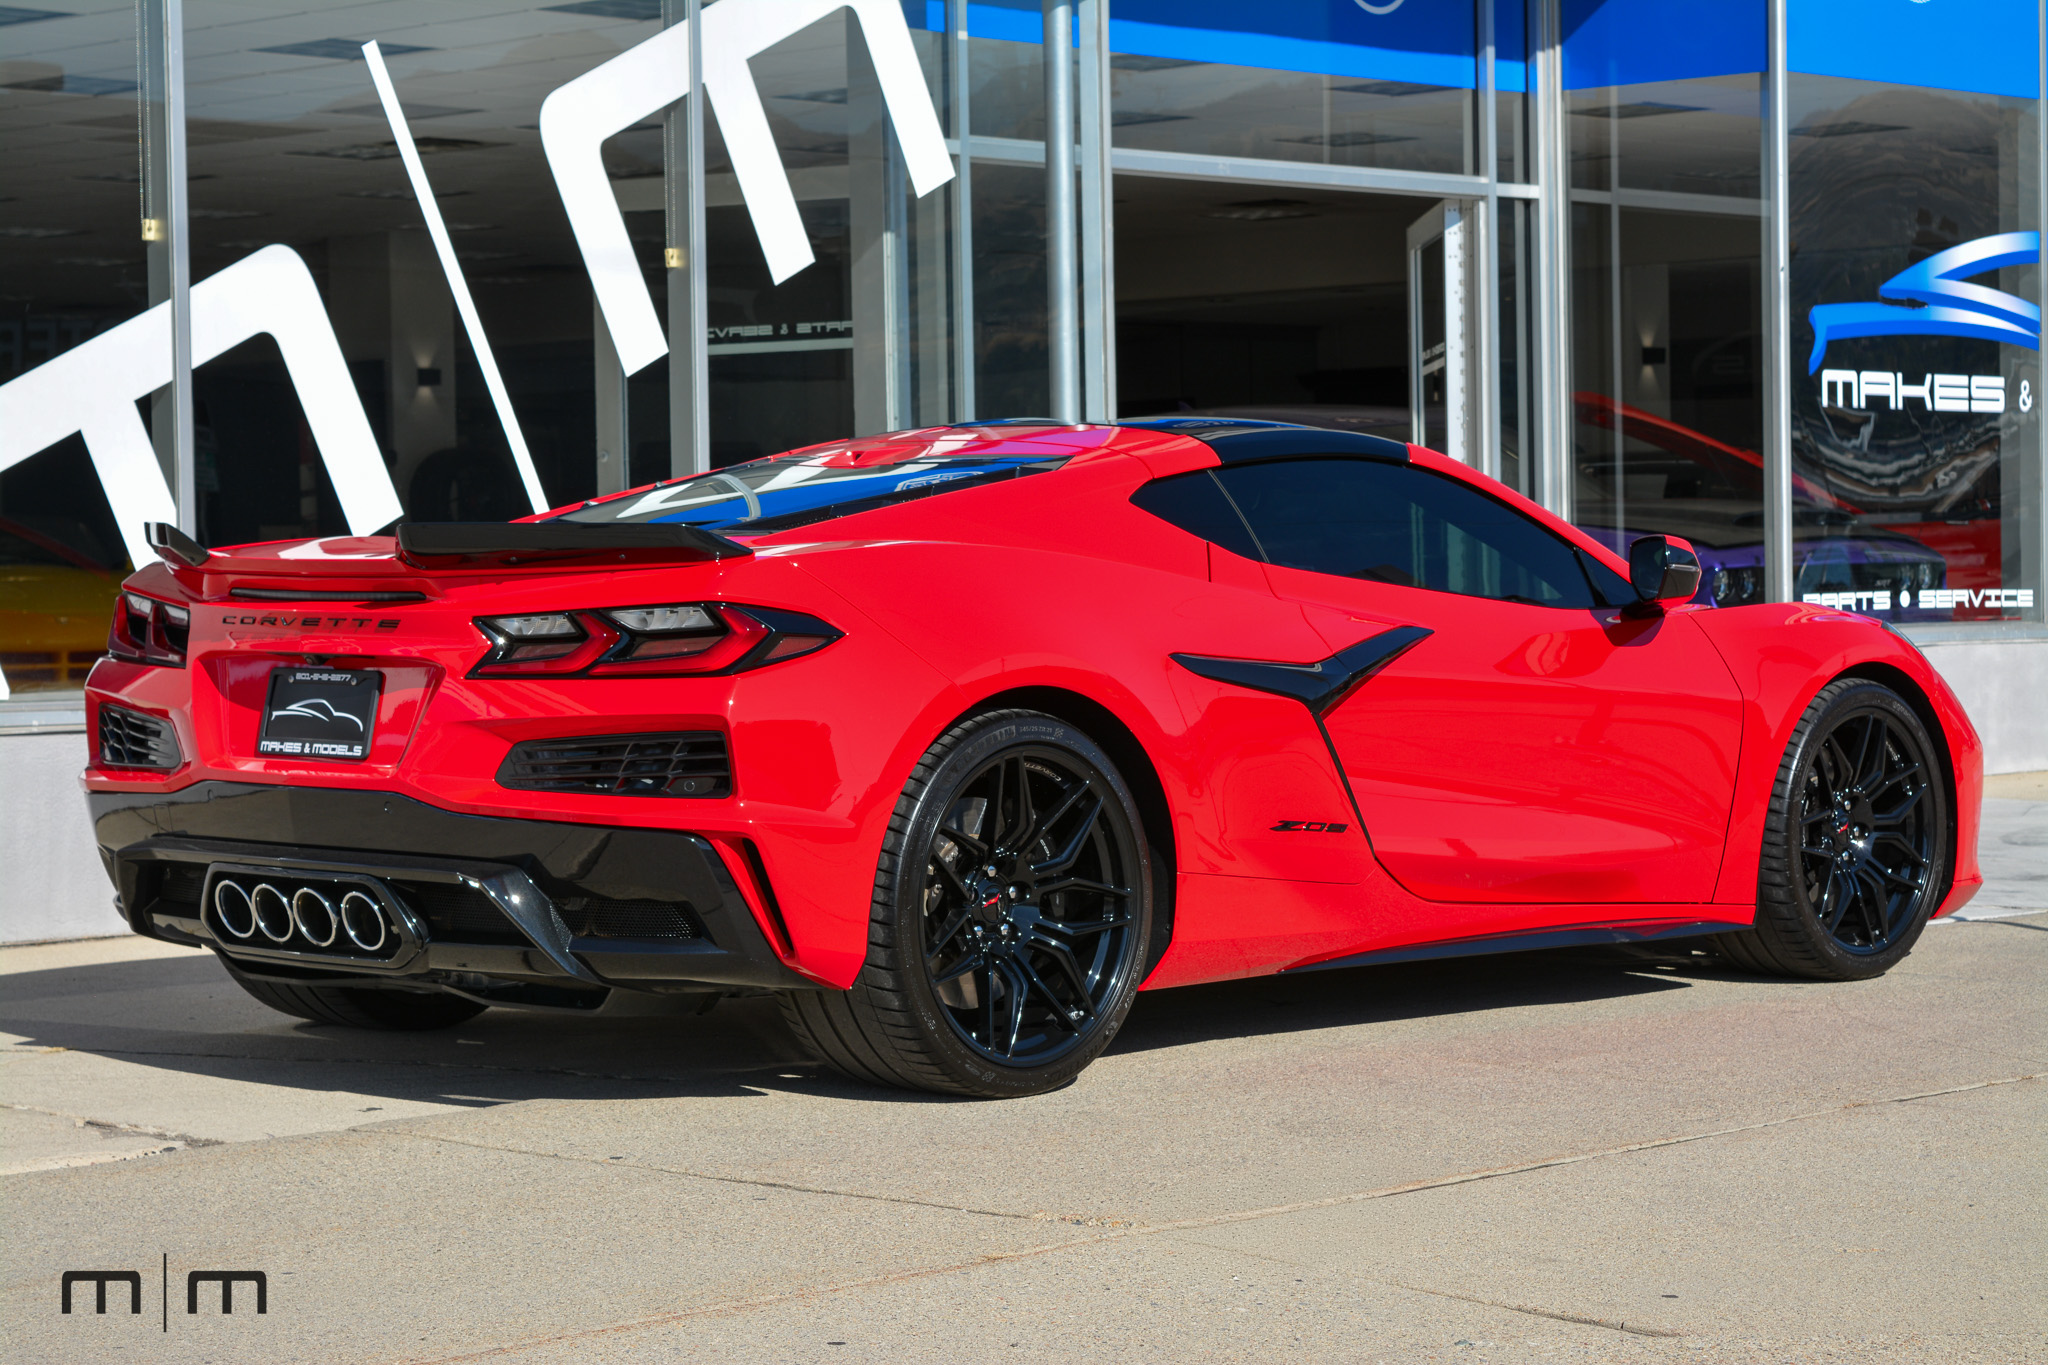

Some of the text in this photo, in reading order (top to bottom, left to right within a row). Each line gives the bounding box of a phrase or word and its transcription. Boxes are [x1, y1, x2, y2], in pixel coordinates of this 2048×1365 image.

[1821, 369, 2033, 413] MAKES &
[1918, 589, 2034, 608] SERVICE
[222, 615, 402, 629] CORVETTE
[260, 740, 363, 756] MAKES & MODELS
[1269, 820, 1349, 833] Z06
